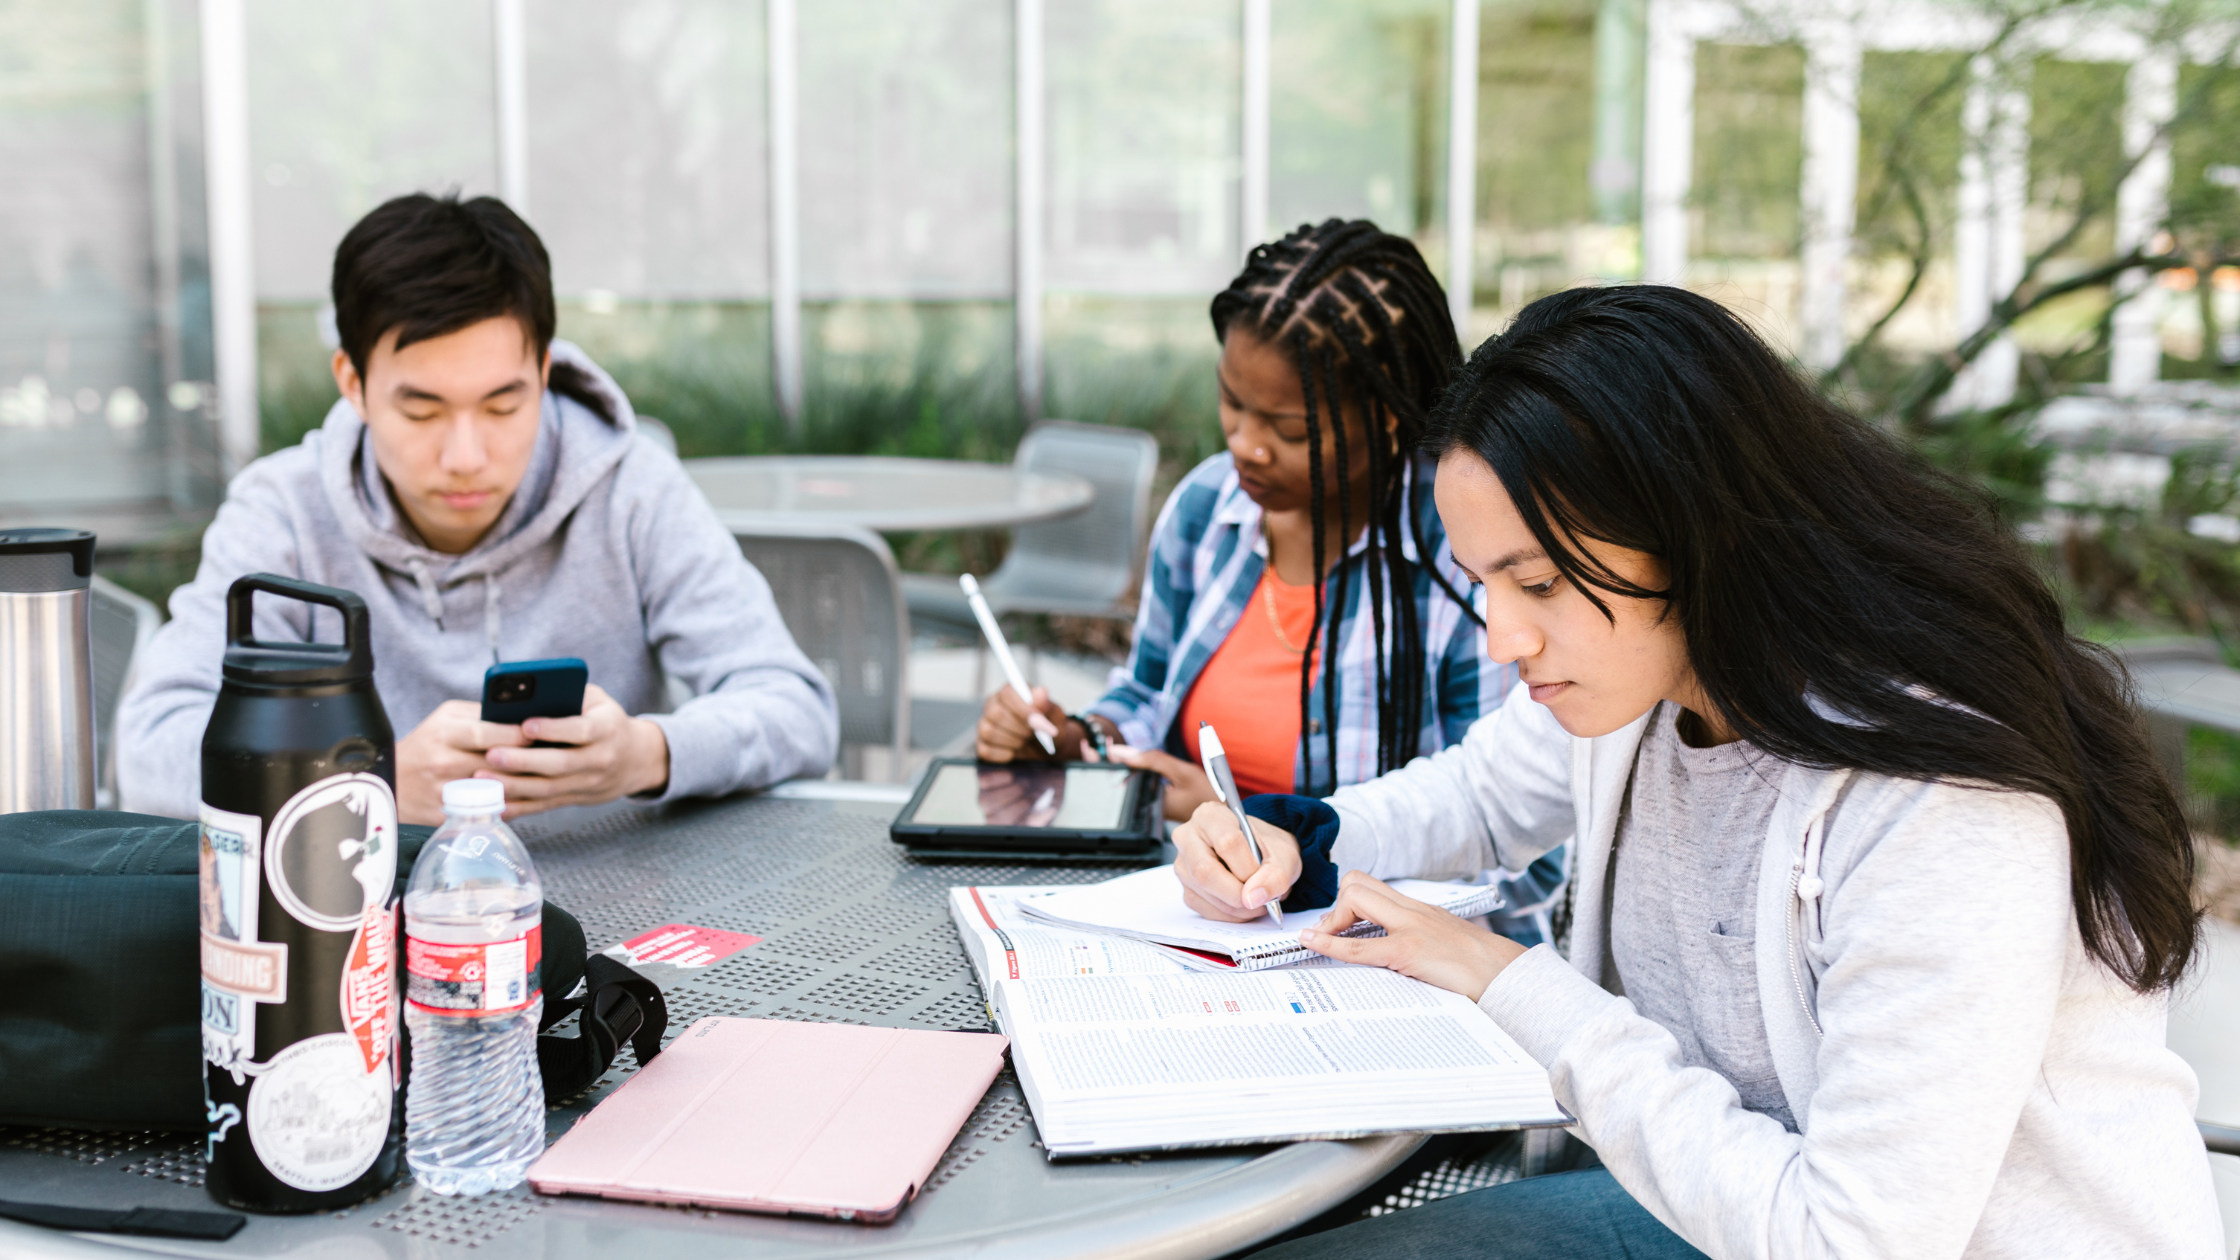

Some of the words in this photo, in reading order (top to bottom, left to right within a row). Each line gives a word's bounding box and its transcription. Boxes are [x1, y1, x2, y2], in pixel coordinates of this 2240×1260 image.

[202, 987, 233, 1030] ON
[349, 965, 370, 1030] VANS
[369, 966, 389, 1017] THE
